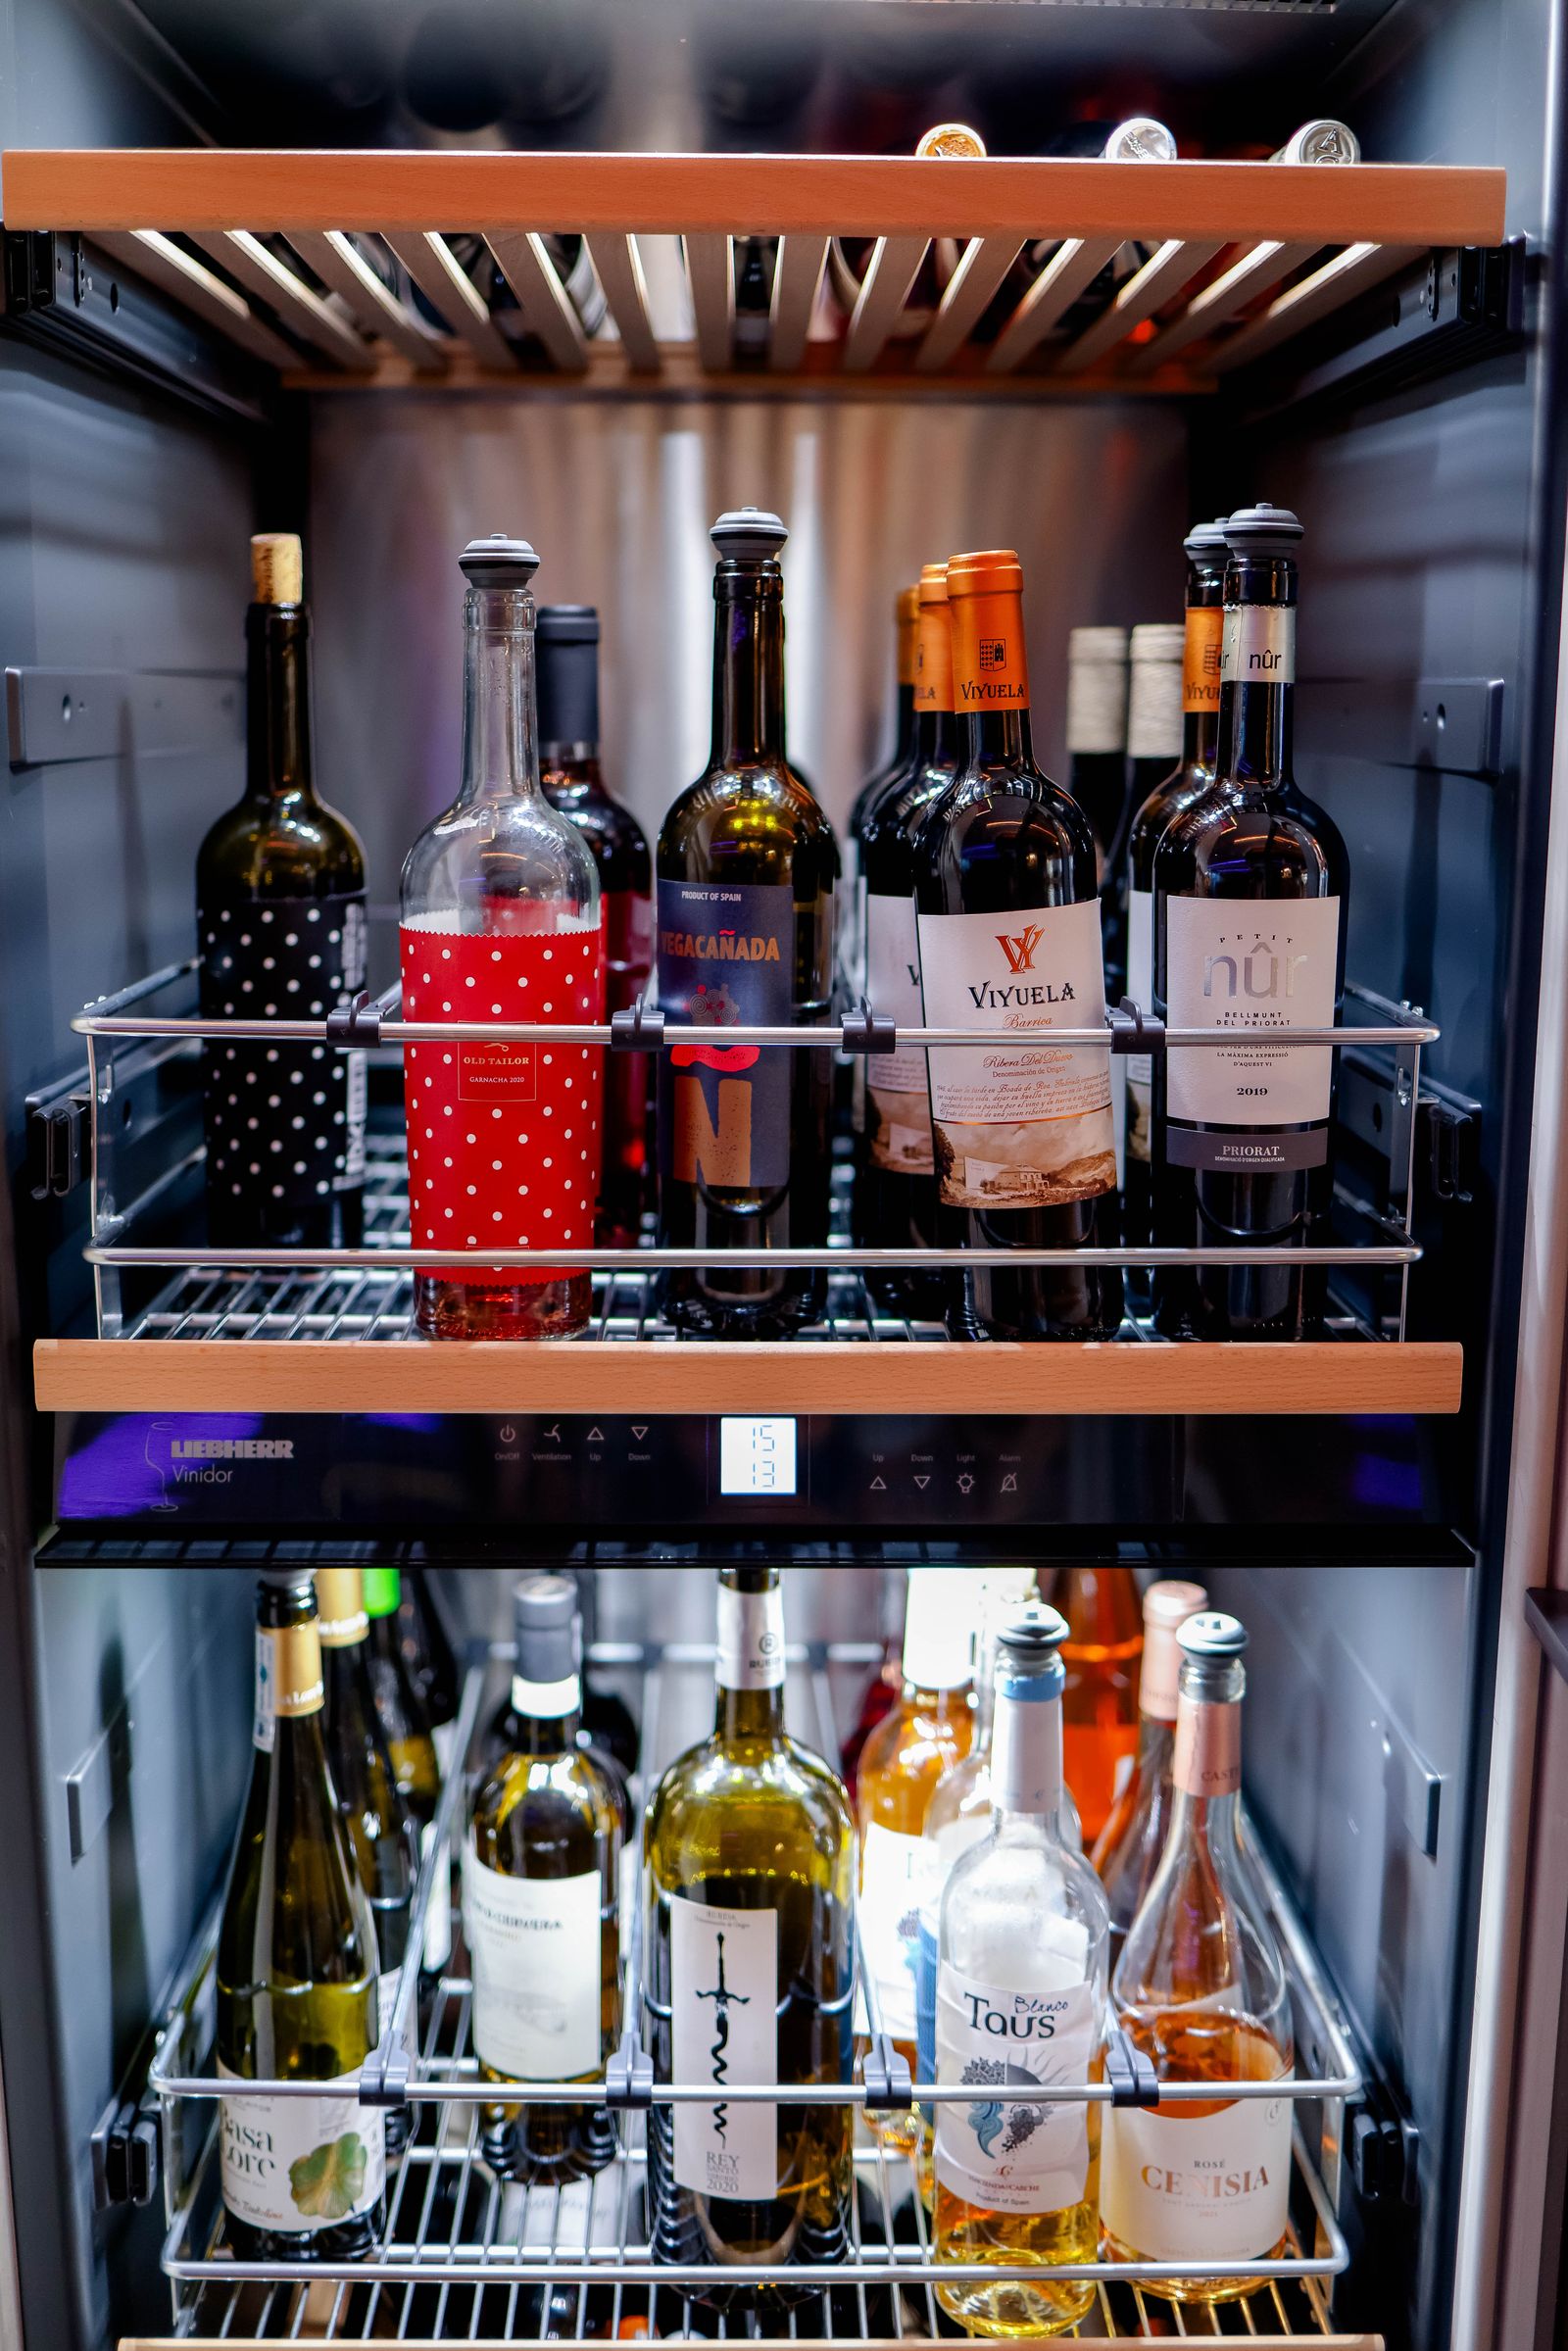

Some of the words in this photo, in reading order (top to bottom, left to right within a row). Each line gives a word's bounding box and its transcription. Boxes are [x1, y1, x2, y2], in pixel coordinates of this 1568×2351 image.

[1249, 649, 1282, 669] nûr
[961, 680, 1025, 700] VIYUELA
[681, 891, 709, 901] PRODUCT
[720, 893, 742, 902] SPAIN
[1219, 933, 1293, 944] PETIT
[1203, 942, 1308, 999] nûr
[967, 980, 1076, 1009] VIYUELA
[1003, 1012, 1054, 1029] Barrica
[488, 1056, 529, 1065] TAILOR
[983, 1054, 1019, 1068] Ribera
[1236, 1087, 1268, 1097] 2019
[1222, 1145, 1280, 1156] PRIORAT
[753, 1425, 774, 1451] 15
[171, 1440, 294, 1458] LIEBHERR
[589, 1453, 602, 1462] Up
[910, 1453, 934, 1462] Down
[872, 1453, 884, 1463] Up
[172, 1464, 234, 1483] Vinidor
[753, 1460, 774, 1487] 13
[1014, 1995, 1069, 2014] Blanco
[964, 1991, 1055, 2038] Taus
[1194, 2159, 1226, 2169] ROSÉ
[1141, 2165, 1269, 2198] CENISIA
